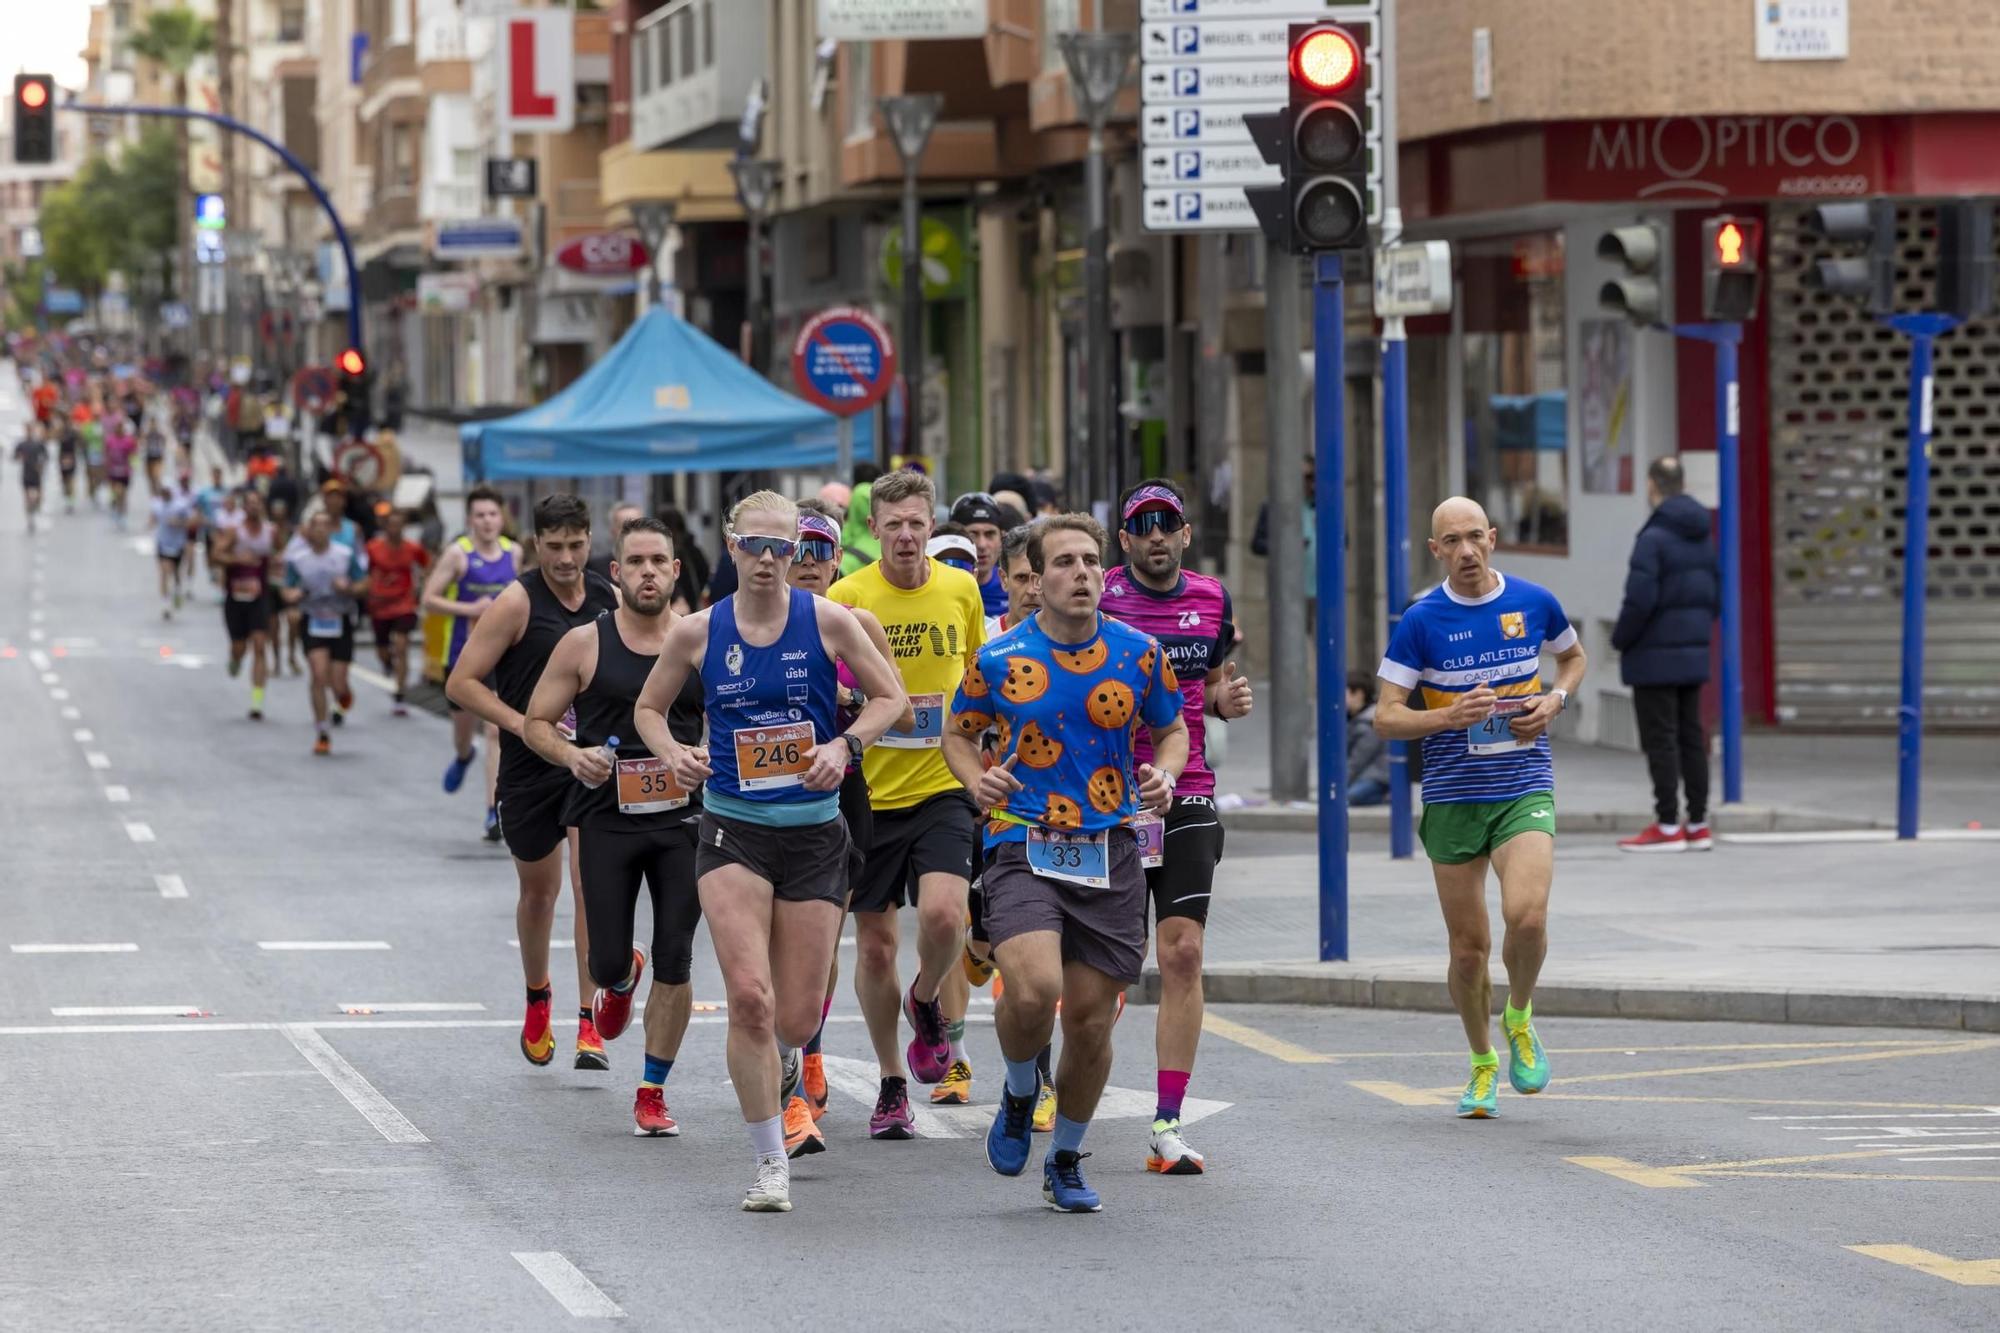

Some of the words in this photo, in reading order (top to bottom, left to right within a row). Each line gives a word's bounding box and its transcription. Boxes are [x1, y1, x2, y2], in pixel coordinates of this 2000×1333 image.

[510, 21, 556, 117] L
[904, 622, 928, 634] AND
[891, 645, 922, 658] WLEY
[1163, 642, 1208, 661] anySa
[1443, 655, 1475, 670] CLUB
[1478, 645, 1537, 664] ATLETISME
[1464, 665, 1523, 683] CASTALLA
[917, 711, 929, 729] 3
[753, 743, 799, 768] 246
[641, 774, 667, 793] 35
[1052, 846, 1082, 868] 33
